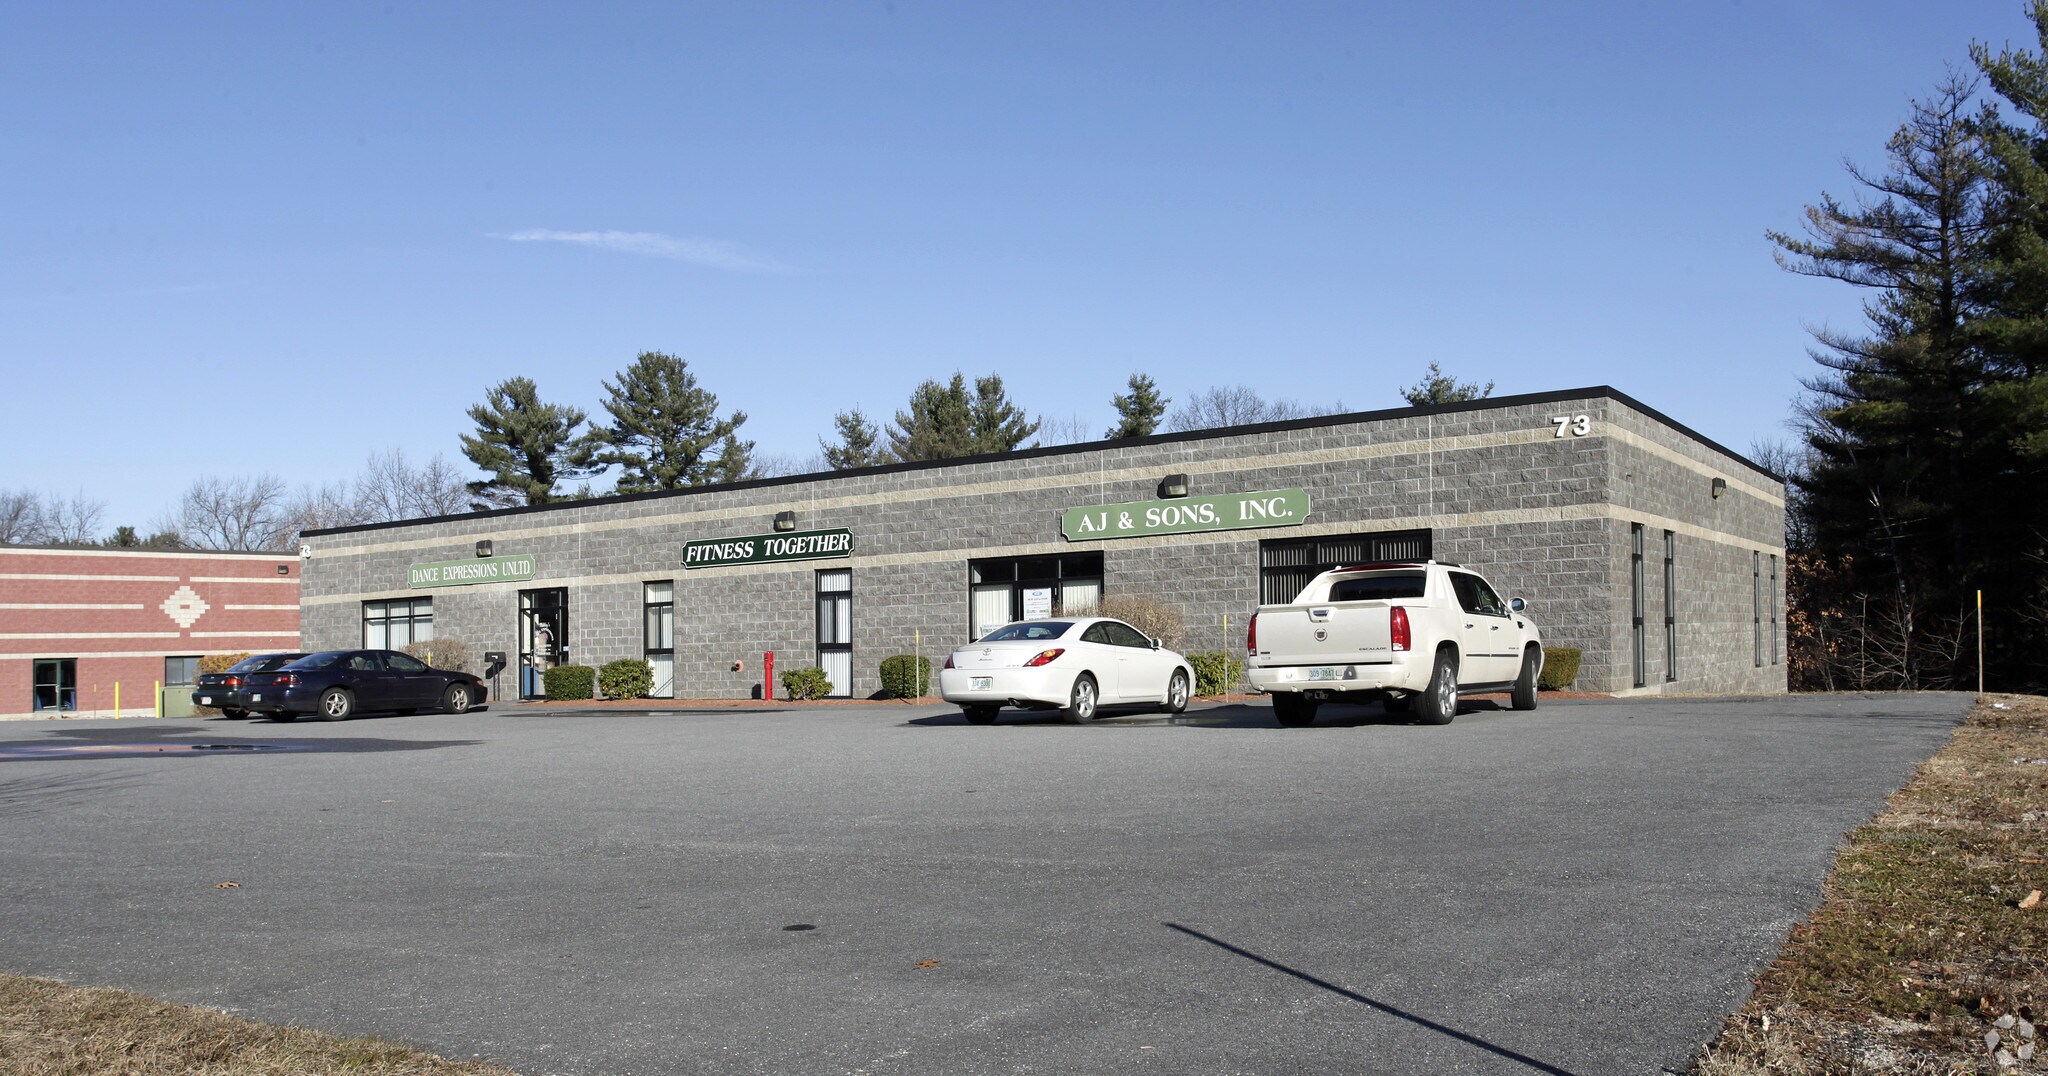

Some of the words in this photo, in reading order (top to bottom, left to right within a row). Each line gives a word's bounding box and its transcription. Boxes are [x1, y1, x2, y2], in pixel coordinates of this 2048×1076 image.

[1553, 414, 1591, 437] 73
[1077, 512, 1108, 533] AJ
[1118, 511, 1135, 530] &
[1145, 503, 1220, 526] SONS,
[1239, 497, 1293, 520] INC.
[686, 541, 754, 563] FITNESS
[764, 533, 850, 556] TOGETHER
[412, 567, 439, 583] DANCE
[443, 562, 498, 580] EXPRESSIONS
